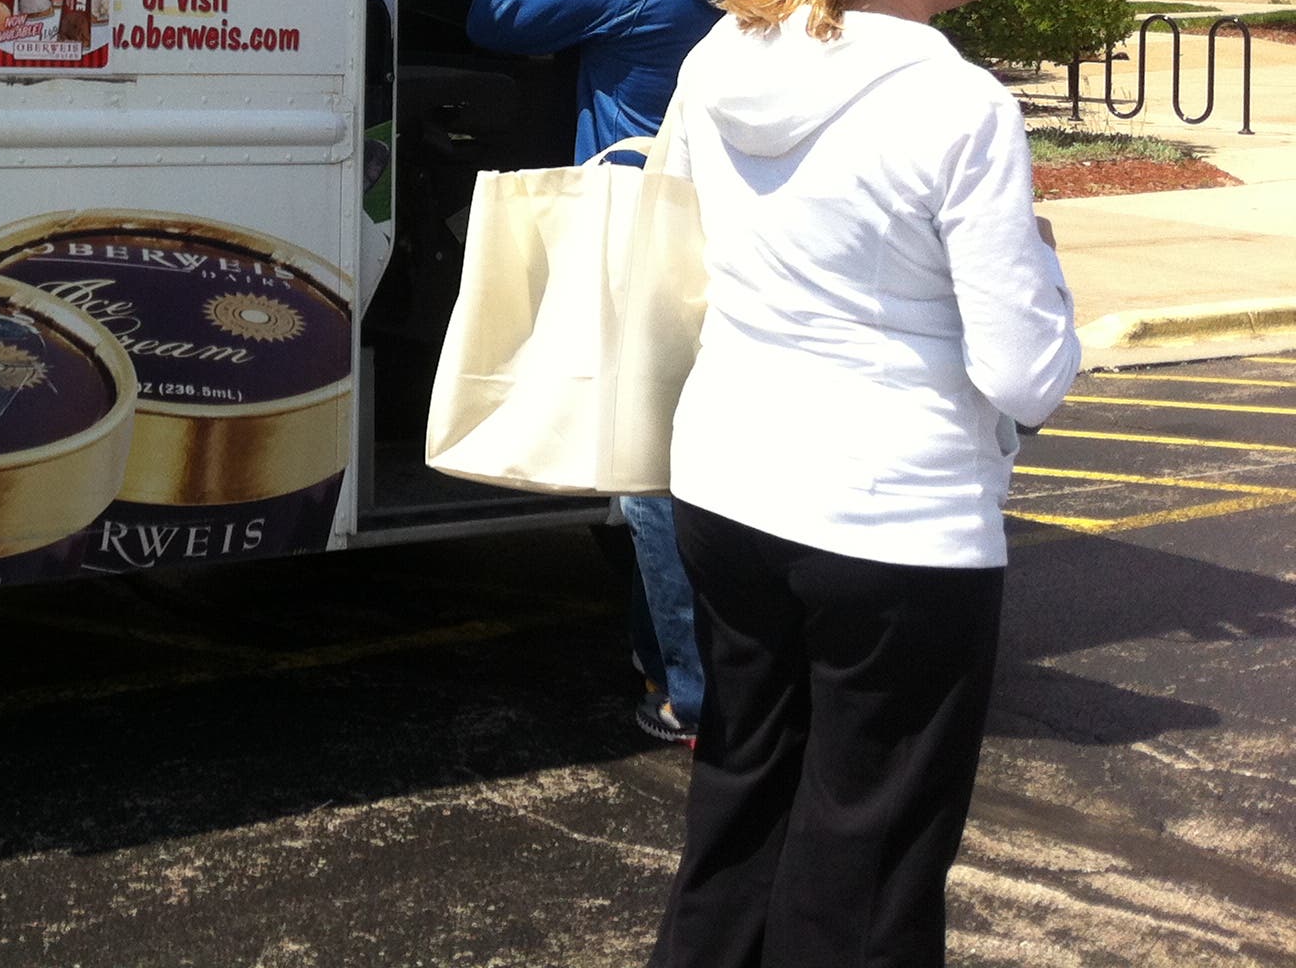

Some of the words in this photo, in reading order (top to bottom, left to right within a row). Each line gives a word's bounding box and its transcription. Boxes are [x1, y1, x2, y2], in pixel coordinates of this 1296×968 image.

[16, 43, 79, 54] OBERWEIS
[23, 242, 295, 280] OBERWEIS
[98, 517, 266, 569] RWEIS
